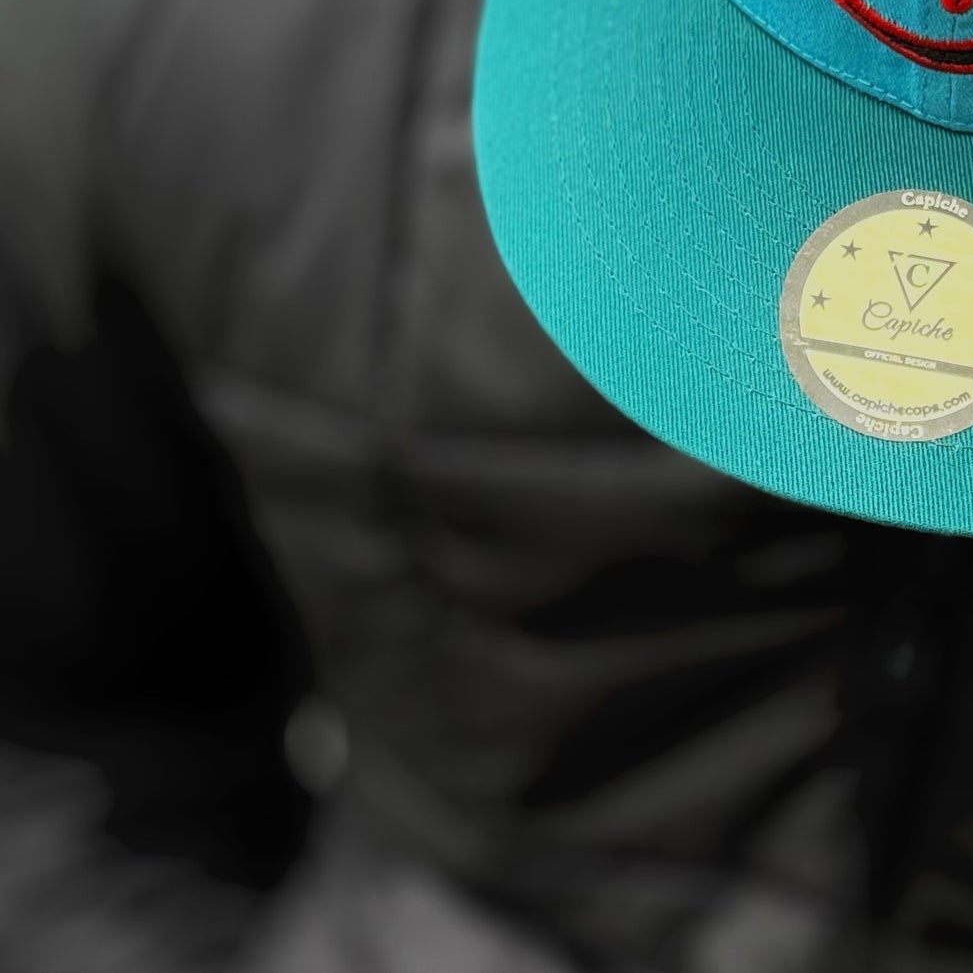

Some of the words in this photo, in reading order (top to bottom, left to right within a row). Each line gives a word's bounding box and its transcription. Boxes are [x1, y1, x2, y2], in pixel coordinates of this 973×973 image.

[901, 192, 968, 219] Capiche
[906, 263, 930, 288] C
[862, 299, 954, 341] Capiche
[904, 353, 937, 370] DESIGN
[822, 368, 971, 417] www.capichecaps.com
[855, 413, 924, 439] Capiche
